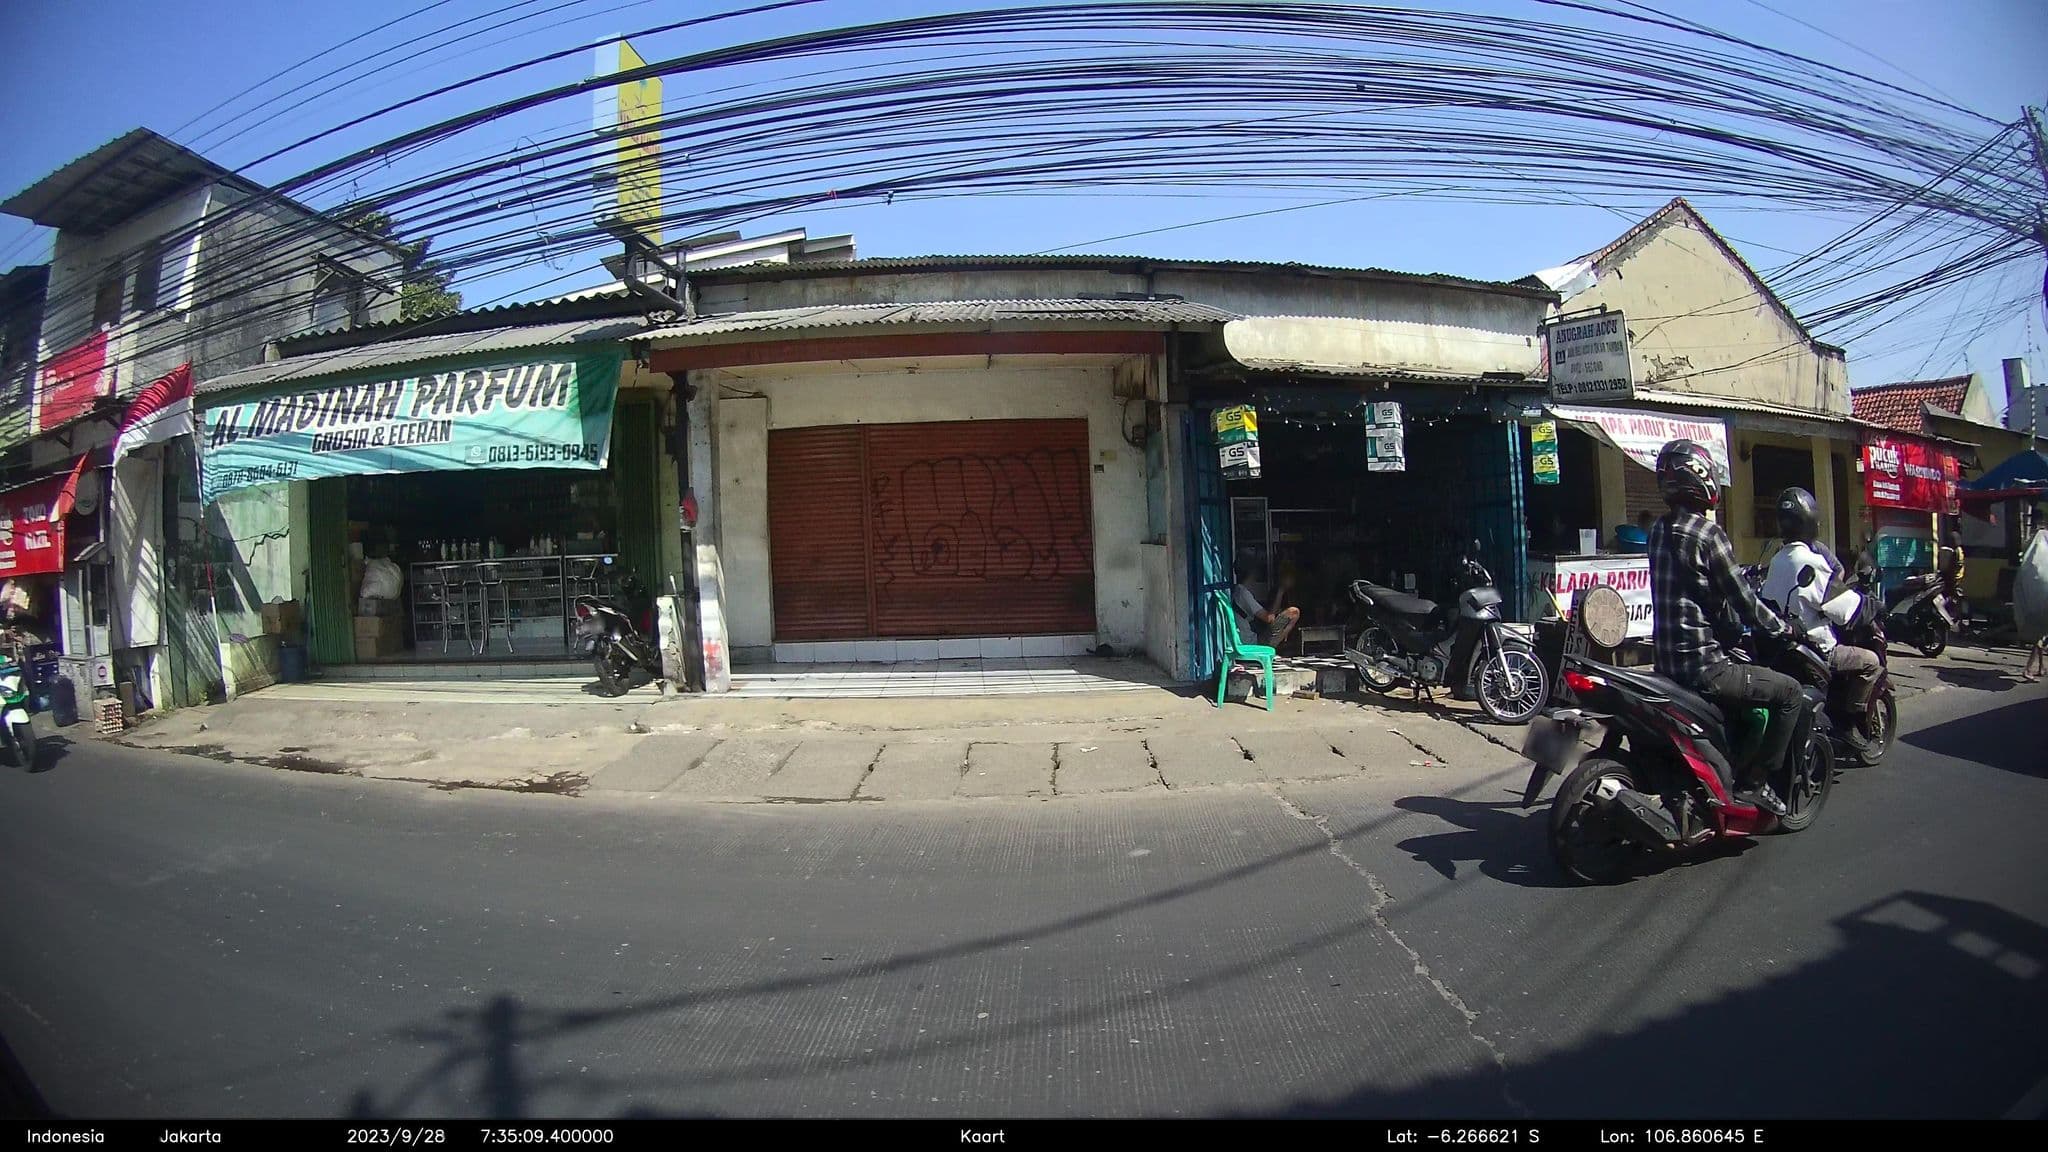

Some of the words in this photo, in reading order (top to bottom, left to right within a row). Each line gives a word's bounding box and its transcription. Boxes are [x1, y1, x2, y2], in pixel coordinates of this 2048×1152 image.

[1556, 323, 1594, 344] ANUGRAH
[1595, 319, 1617, 336] ACCU
[211, 406, 241, 450] AL
[246, 379, 404, 437] MADINAH
[411, 361, 573, 417] PARFUM
[1226, 411, 1242, 421] GS
[312, 432, 368, 453] GROSIR
[371, 427, 385, 446] &
[389, 420, 452, 446] ECERAN
[1538, 426, 1553, 434] GS
[1629, 419, 1667, 439] PARUT
[1669, 423, 1713, 441] SANTAN
[489, 444, 598, 463] 0813-6193-0945
[1229, 446, 1245, 457] GS
[1384, 442, 1396, 450] GS
[1540, 456, 1554, 465] GS
